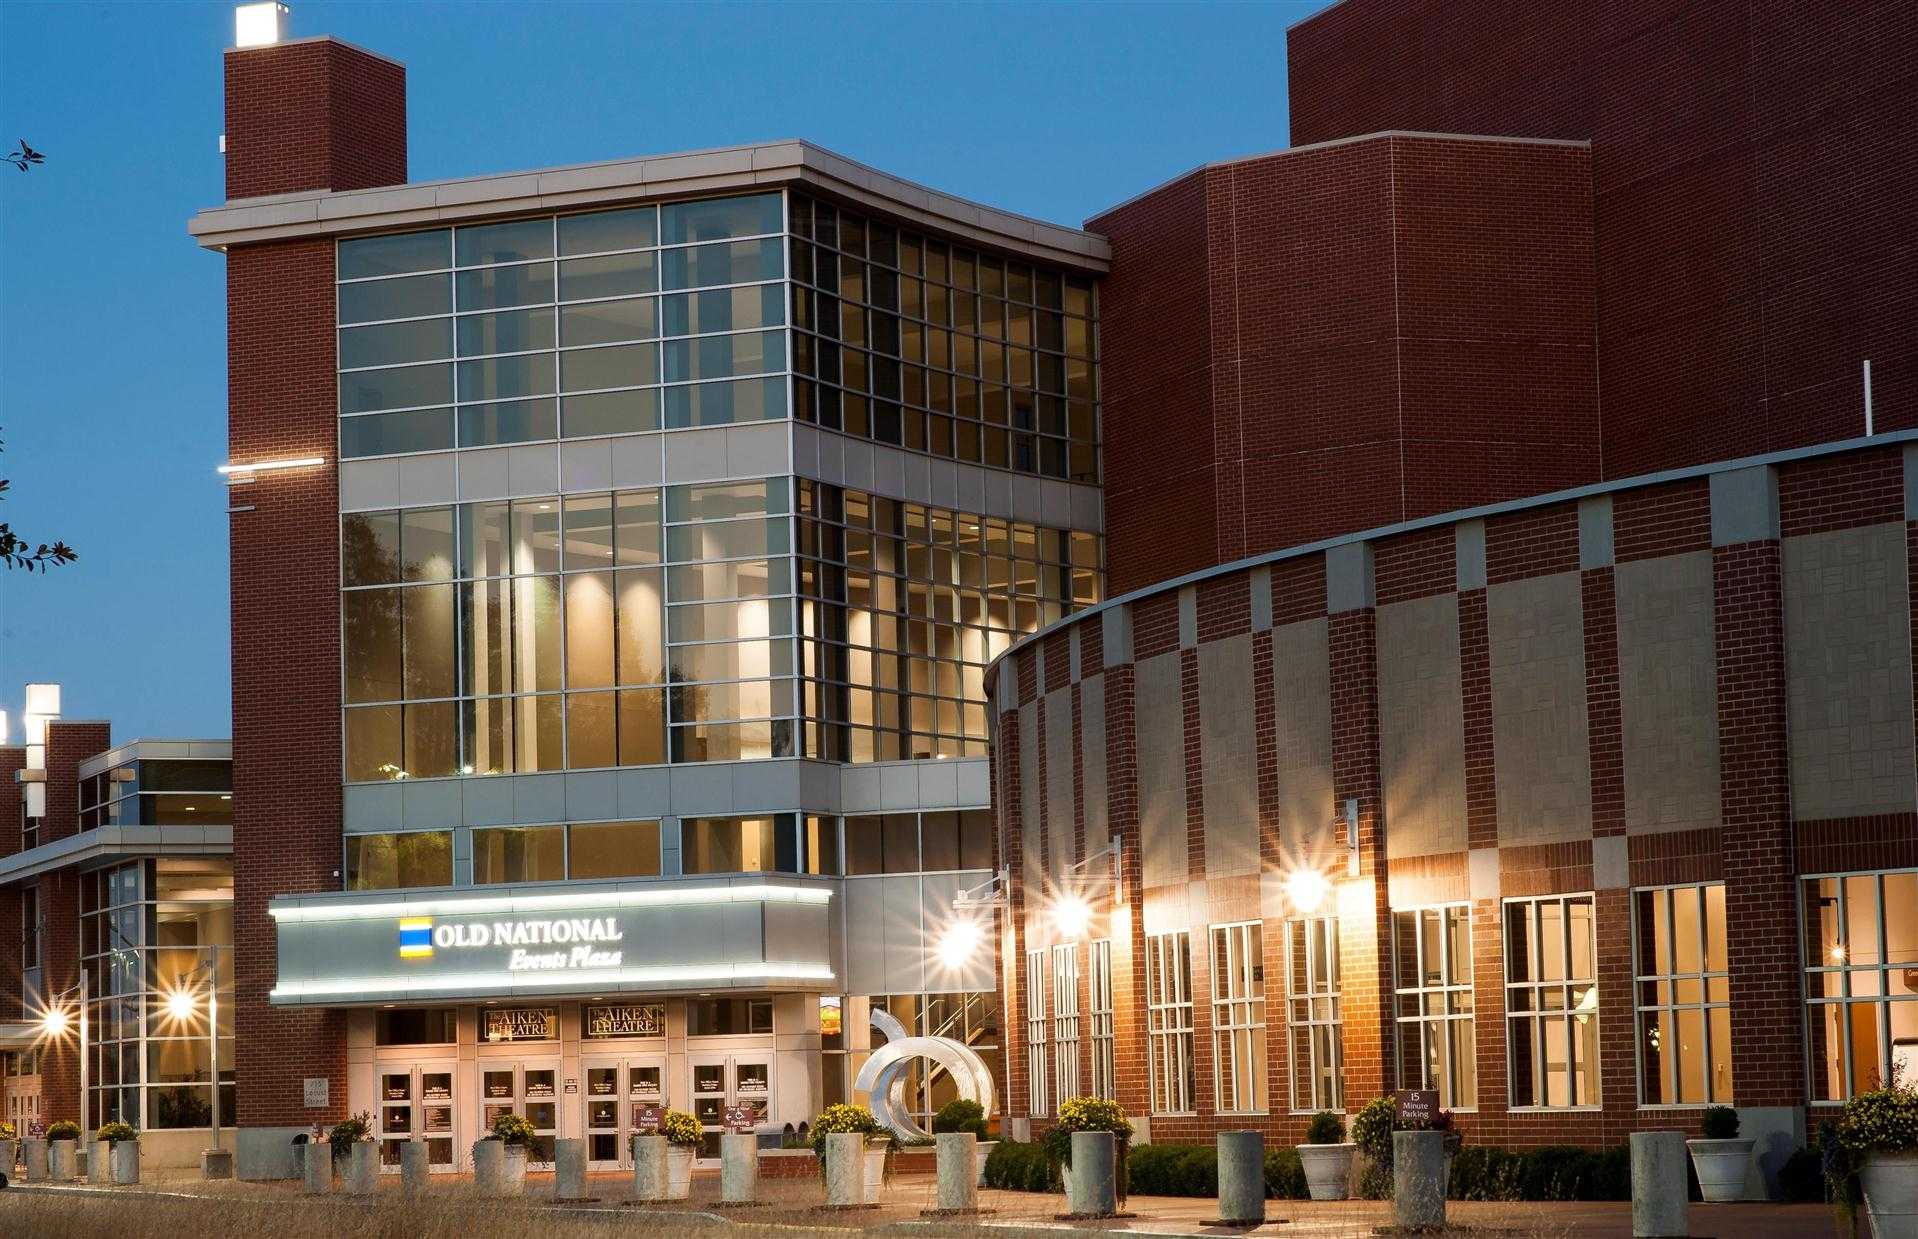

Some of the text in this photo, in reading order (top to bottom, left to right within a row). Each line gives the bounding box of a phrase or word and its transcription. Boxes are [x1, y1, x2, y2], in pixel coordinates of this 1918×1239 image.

[434, 917, 623, 947] OLD NATIONAL
[508, 945, 622, 970] Events Plaza
[499, 1011, 548, 1024] AIKEN
[599, 1007, 654, 1020] AIKEN
[489, 1023, 549, 1035] THEATRE
[592, 1019, 655, 1032] THEATRE
[1410, 1092, 1420, 1100] 15
[645, 1109, 653, 1117] 15
[1402, 1111, 1430, 1119] Parking
